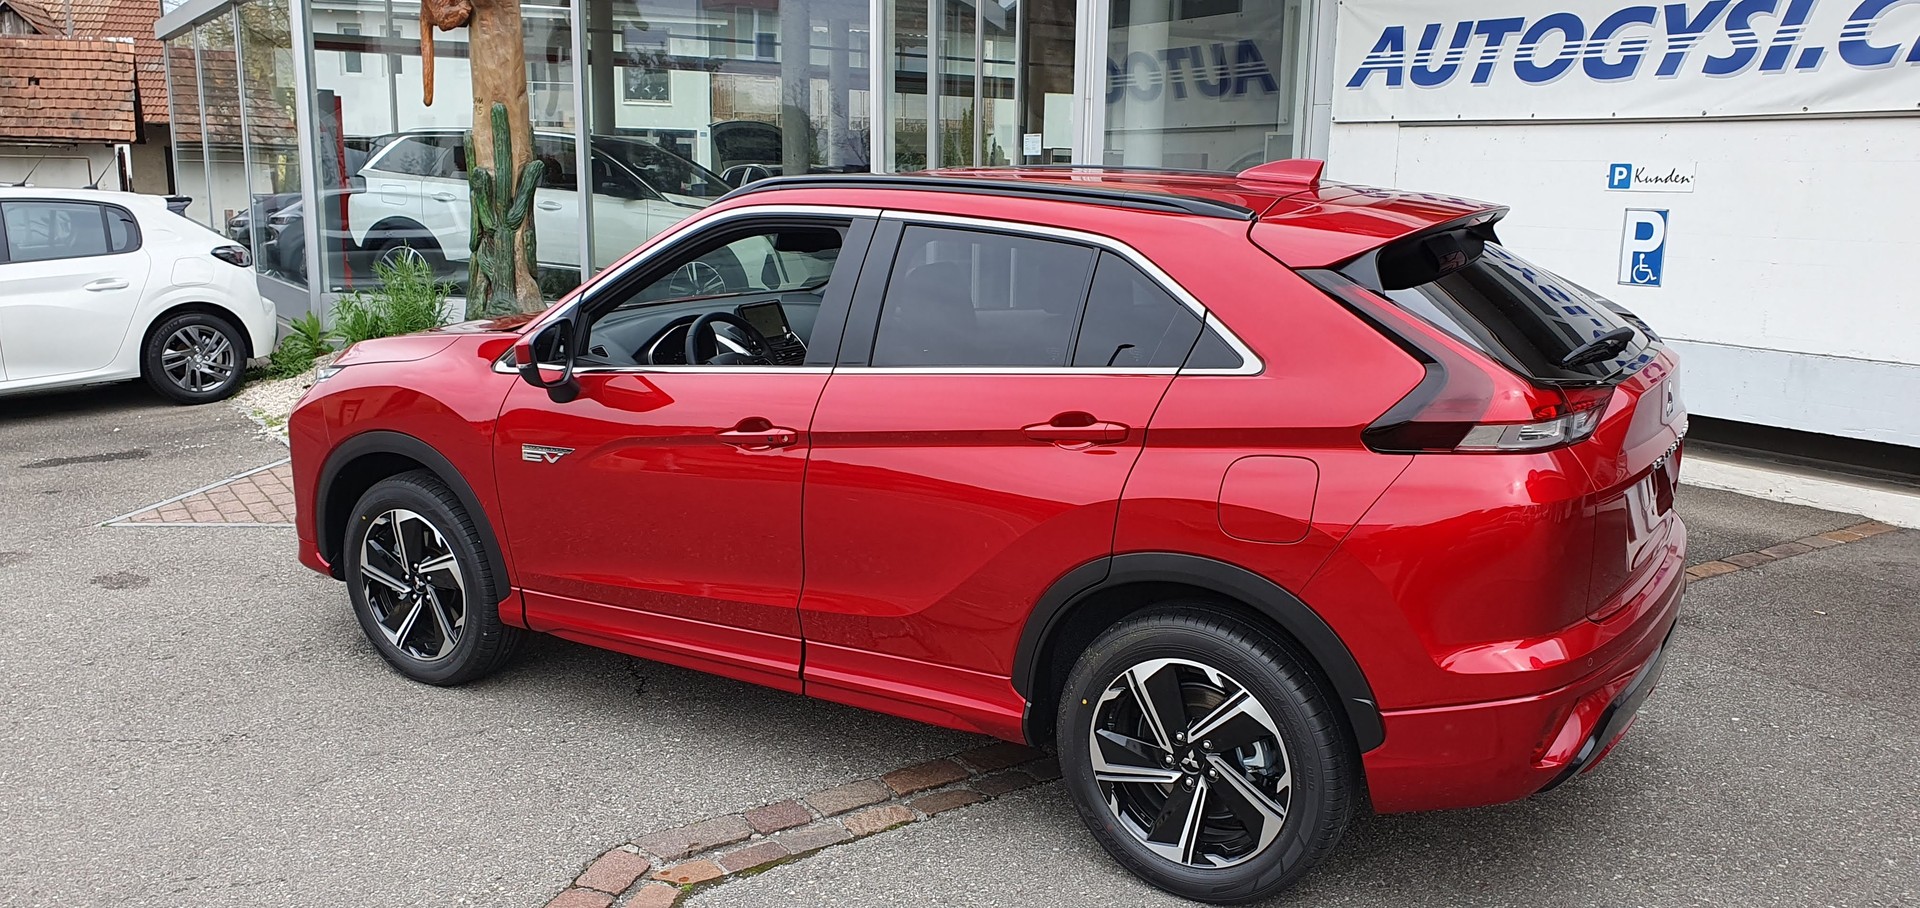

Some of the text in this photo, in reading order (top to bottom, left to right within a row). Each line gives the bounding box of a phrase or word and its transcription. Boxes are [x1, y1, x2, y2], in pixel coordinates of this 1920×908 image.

[1346, 0, 1920, 88] AUTOGYSI.C
[1613, 167, 1690, 186] P Kunden
[1620, 210, 1666, 283] P
[522, 448, 568, 464] EV
